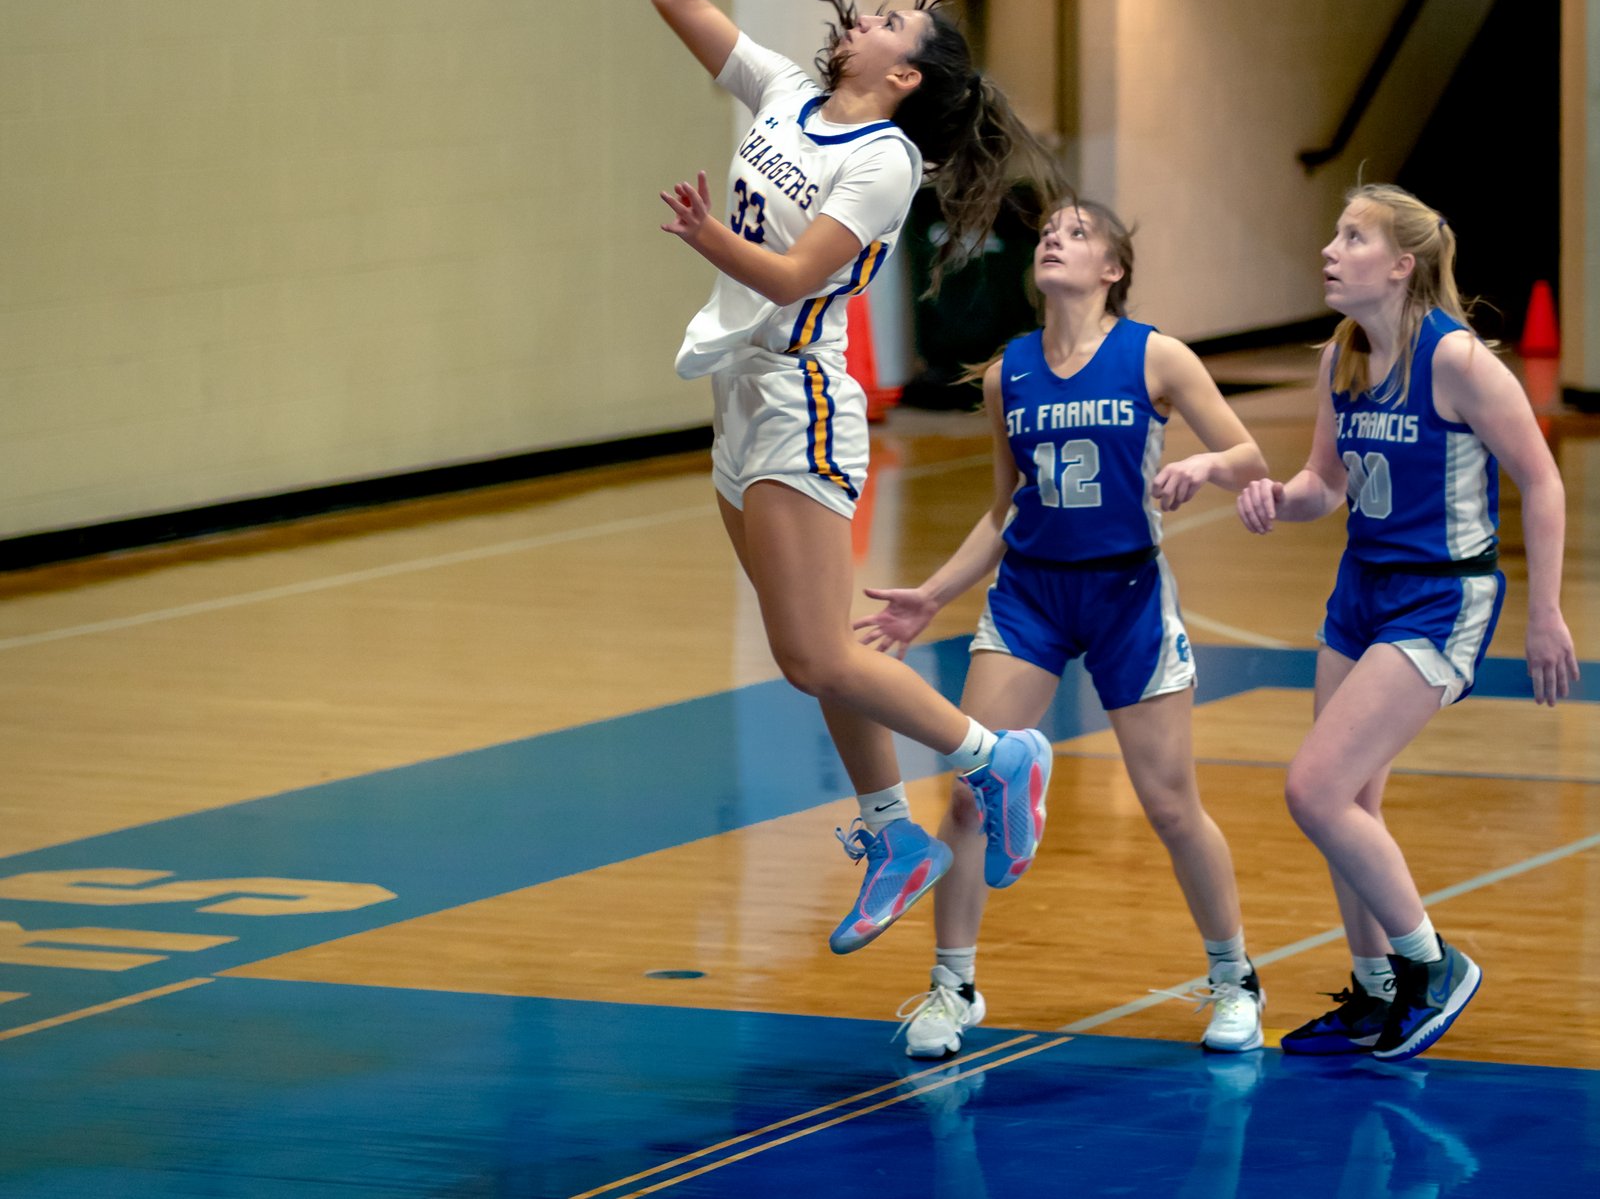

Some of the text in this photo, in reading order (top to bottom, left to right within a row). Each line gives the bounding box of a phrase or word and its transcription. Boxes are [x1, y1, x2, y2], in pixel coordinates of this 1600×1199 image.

[730, 177, 766, 245] 33
[1006, 399, 1135, 438] ST. FRANCIS
[1032, 438, 1102, 508] 12
